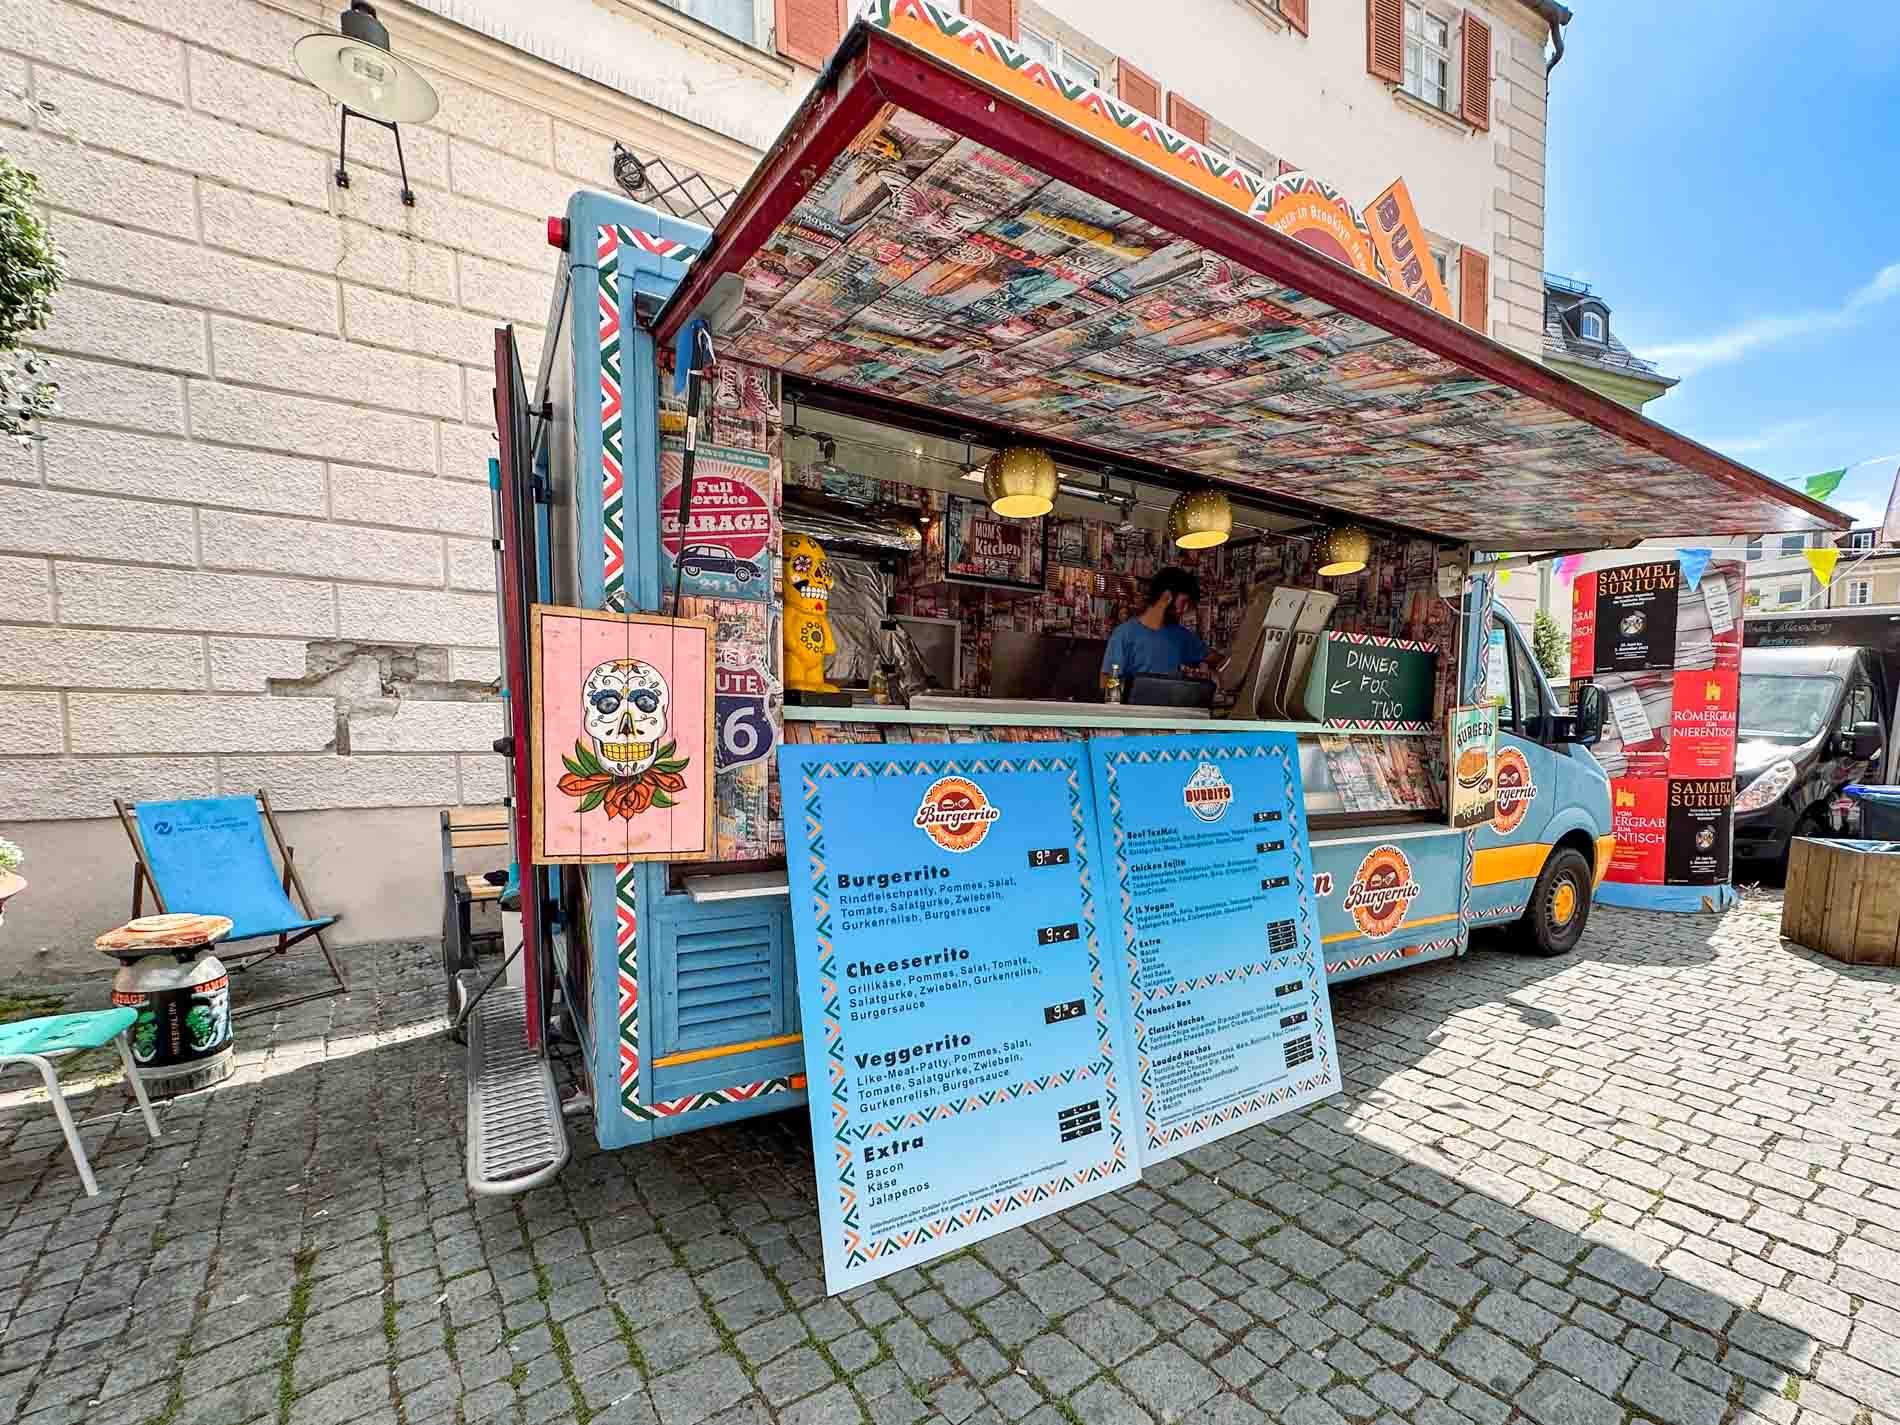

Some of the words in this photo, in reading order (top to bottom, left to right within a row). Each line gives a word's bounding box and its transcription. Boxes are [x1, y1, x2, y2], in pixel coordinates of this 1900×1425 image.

[696, 481, 733, 493] Full
[690, 494, 748, 505] ervice
[663, 513, 769, 533] GARAGE
[975, 538, 1021, 556] Kitchen
[1599, 564, 1676, 584] SAMMEL
[1599, 577, 1675, 596] SURIUM
[1346, 650, 1399, 677] DINNER
[715, 674, 758, 692] UTE
[1360, 674, 1390, 698] FOR
[1371, 700, 1403, 719] TWO
[1457, 722, 1492, 748] BURGERS
[1673, 727, 1735, 737] NIERENTISCH
[1671, 782, 1731, 794] SAMMEL
[1671, 794, 1731, 807] SURIUM
[916, 804, 999, 828] Burgerrito
[1615, 817, 1666, 828] ERGRAB
[1613, 832, 1665, 843] ENTISCH
[837, 864, 950, 888] Burgerrito
[1344, 880, 1419, 912] Burgerrito
[1139, 938, 1160, 947] Extra
[846, 947, 969, 978] Cheeserrito
[908, 969, 958, 984] Pommes,
[960, 962, 990, 975] Salat,
[849, 989, 916, 1008] Salatgurke,
[919, 978, 971, 995] Zwiebeln,
[850, 1000, 925, 1021] Burgersauce
[1146, 1003, 1174, 1016] Nachos
[1176, 999, 1191, 1007] Box
[1148, 1021, 1175, 1035] Classic
[1176, 1015, 1204, 1027] Nachos
[854, 1033, 971, 1069] Veggerrito
[953, 1047, 1001, 1063] Pommes,
[1003, 1039, 1031, 1051] Salat,
[1152, 1052, 1182, 1067] Loaded
[1183, 1044, 1211, 1058] Nachos
[858, 1083, 905, 1100] Tomate,
[907, 1066, 972, 1088] Salatgurke,
[973, 1053, 1022, 1071] Zwiebeln,
[859, 1086, 940, 1112] Gurkenrelish,
[942, 1068, 1008, 1092] Burgersauce
[863, 1135, 923, 1163] Extra
[865, 1162, 903, 1179] Bacon
[868, 1181, 929, 1207] Jalapenos
